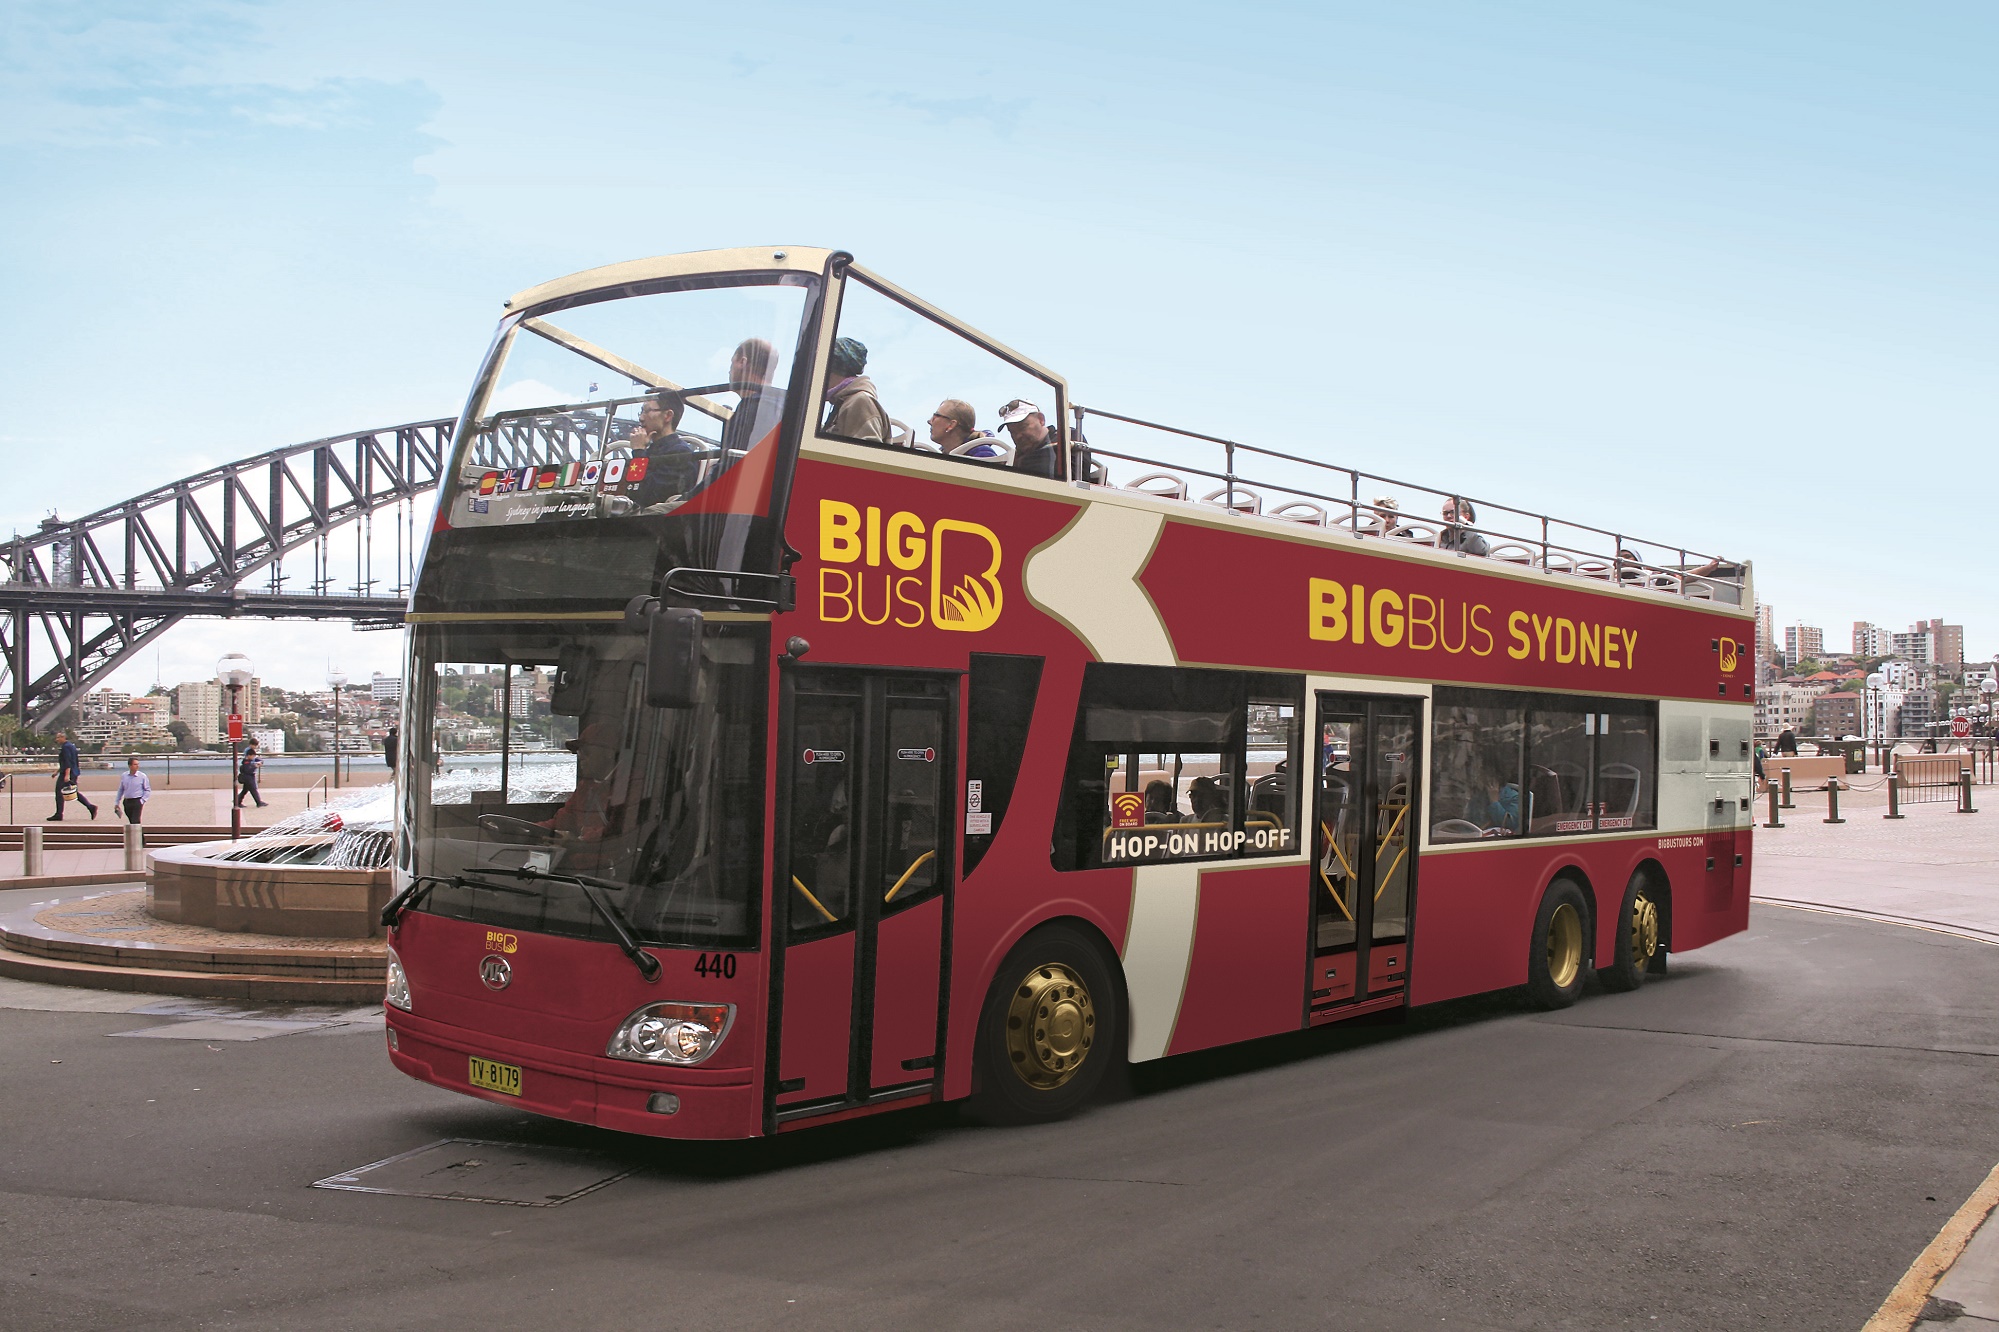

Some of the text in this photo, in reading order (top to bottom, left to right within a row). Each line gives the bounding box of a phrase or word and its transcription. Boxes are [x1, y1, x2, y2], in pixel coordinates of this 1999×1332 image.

[506, 505, 530, 522] Sydney
[531, 504, 539, 514] in
[537, 505, 559, 520] your
[558, 501, 596, 518] language
[820, 499, 926, 570] BIG
[820, 567, 925, 628] BUS
[1507, 610, 1638, 669] SYDNEY
[1951, 721, 1969, 732] STOP
[1557, 820, 1592, 831] EMERGENCY EXIT
[1600, 818, 1632, 828] EMERGENCY EXIT
[1111, 828, 1291, 858] HOP-ON HOP-OFF
[485, 940, 503, 952] BUS
[486, 931, 503, 942] BIG
[694, 952, 737, 979] 440
[471, 1059, 519, 1088] TV-8179
